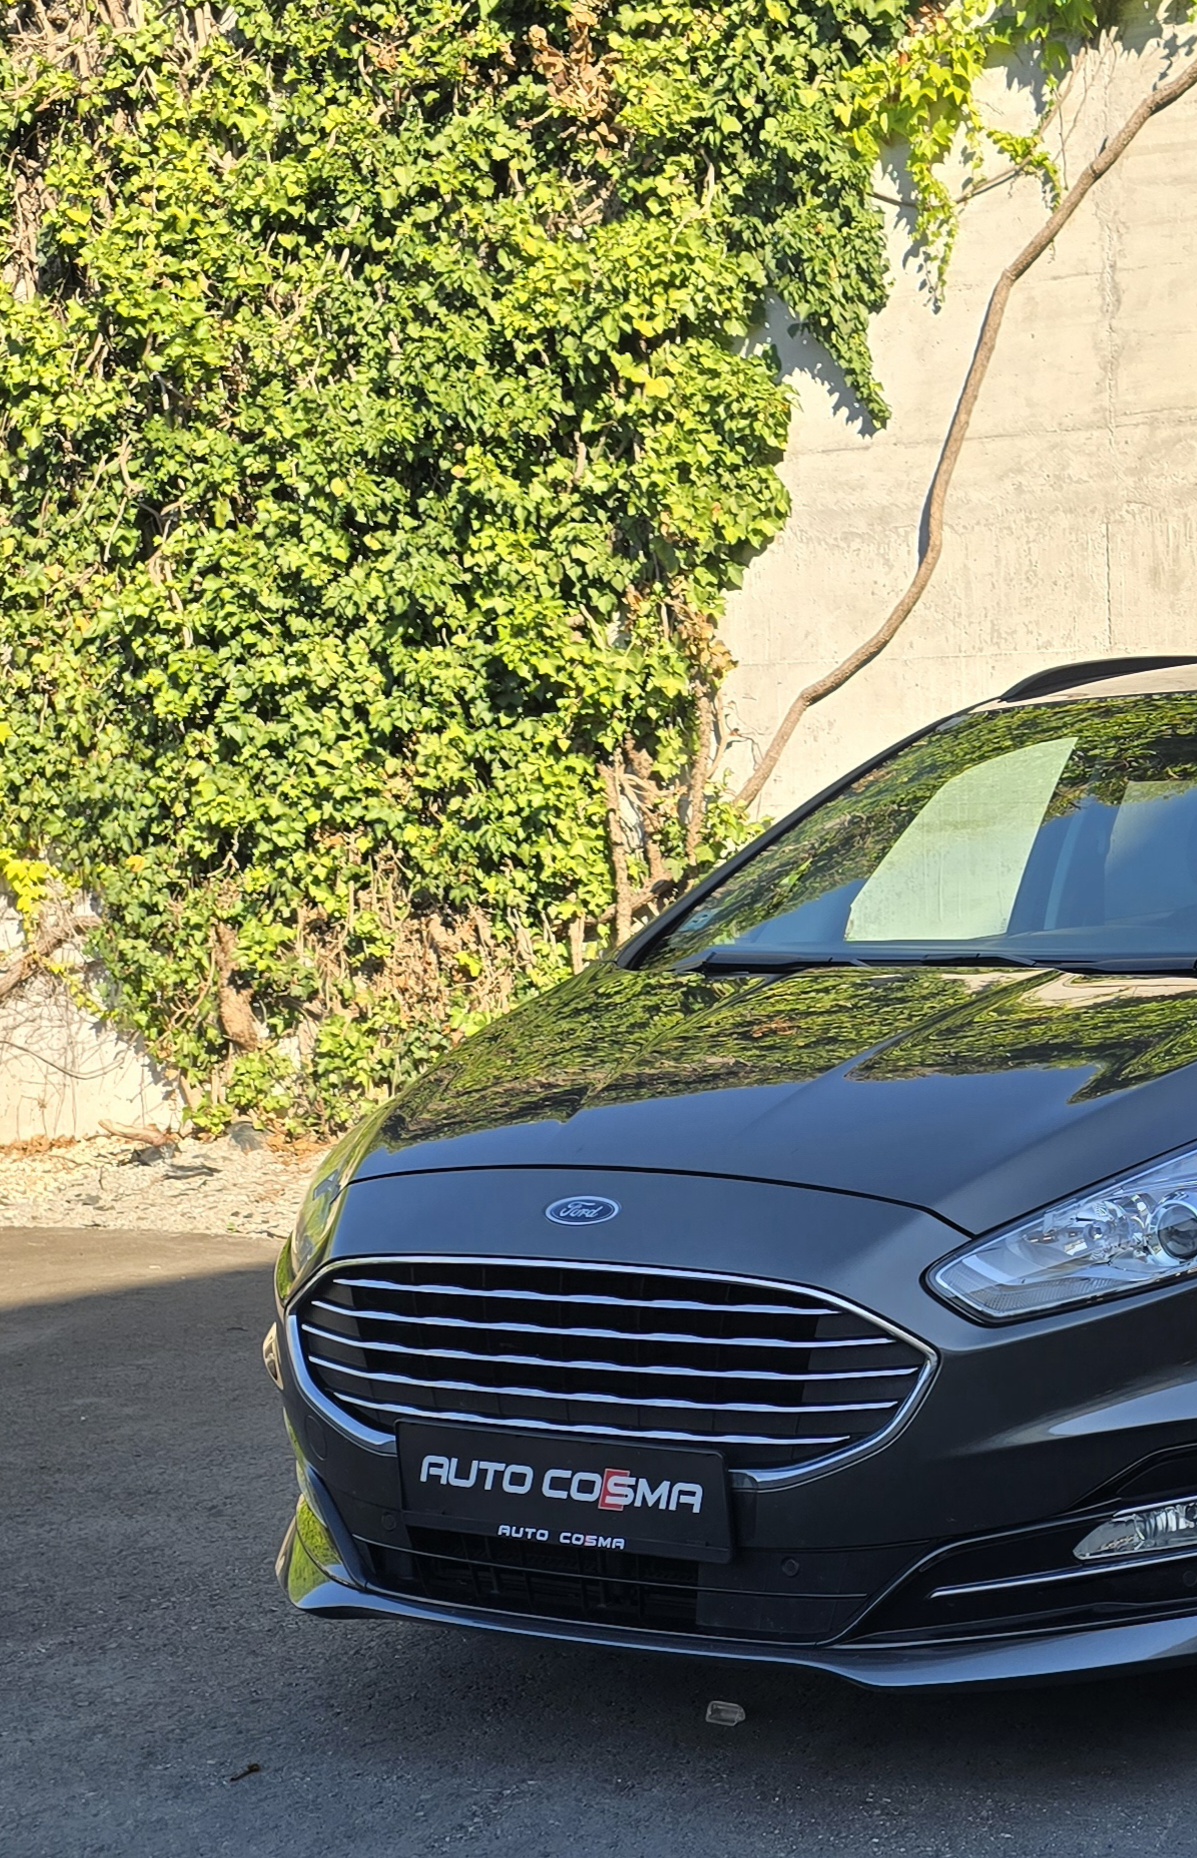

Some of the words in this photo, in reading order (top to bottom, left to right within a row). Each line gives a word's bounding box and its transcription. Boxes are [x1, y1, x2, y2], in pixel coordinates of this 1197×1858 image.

[559, 1201, 603, 1218] Ford
[419, 1454, 534, 1495] AUTO
[541, 1468, 703, 1514] COSMA
[498, 1524, 549, 1541] AUTO
[559, 1532, 626, 1550] COSMA
